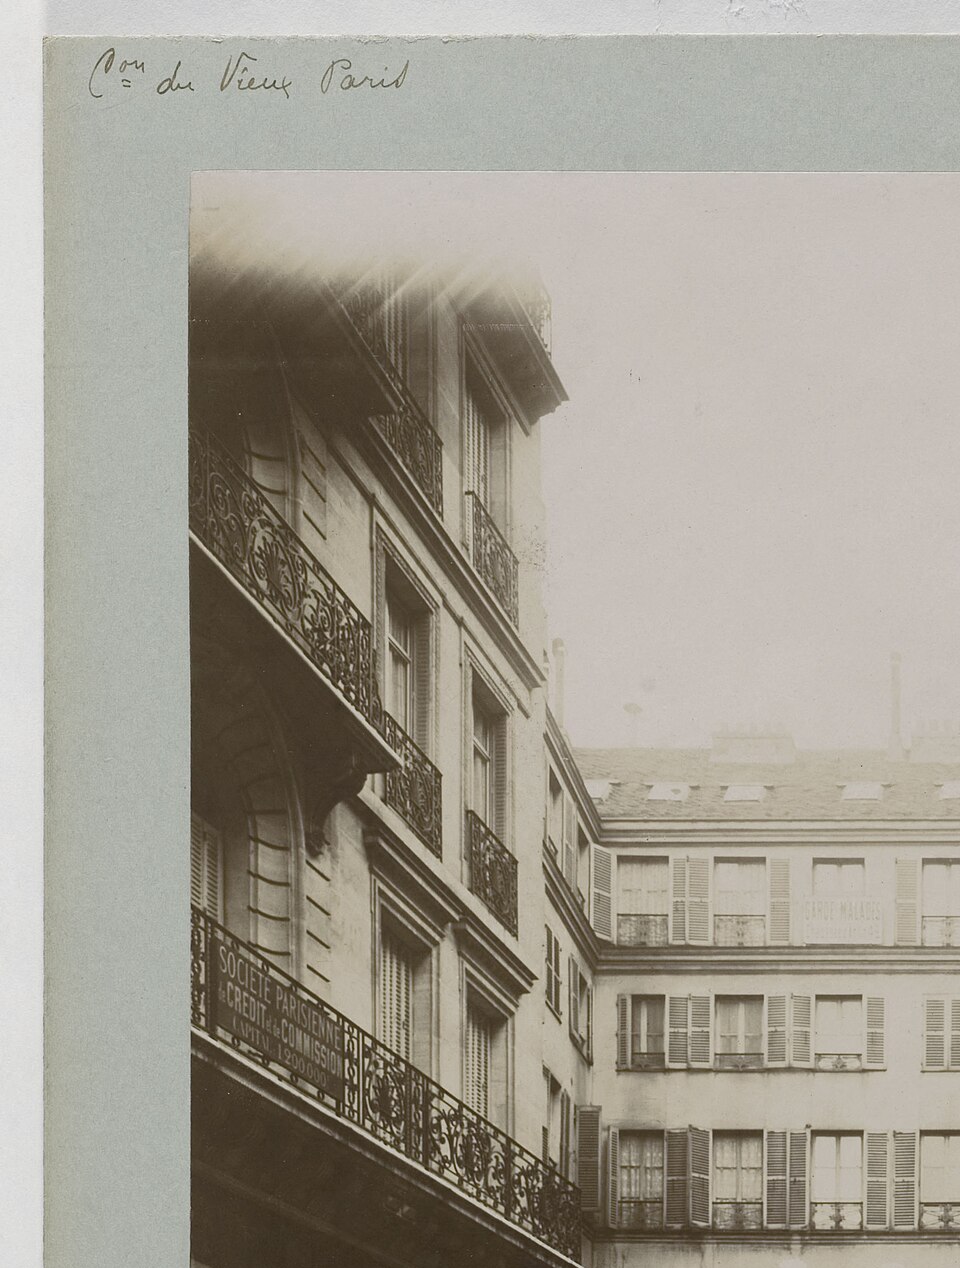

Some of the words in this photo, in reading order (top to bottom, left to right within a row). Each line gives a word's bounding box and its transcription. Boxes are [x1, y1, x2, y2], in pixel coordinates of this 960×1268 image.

[156, 60, 195, 95] du
[219, 50, 294, 100] Vieux
[320, 58, 410, 96] Paris
[276, 985, 342, 1052] PARISIENNE
[281, 1018, 343, 1080] COMMISSION
